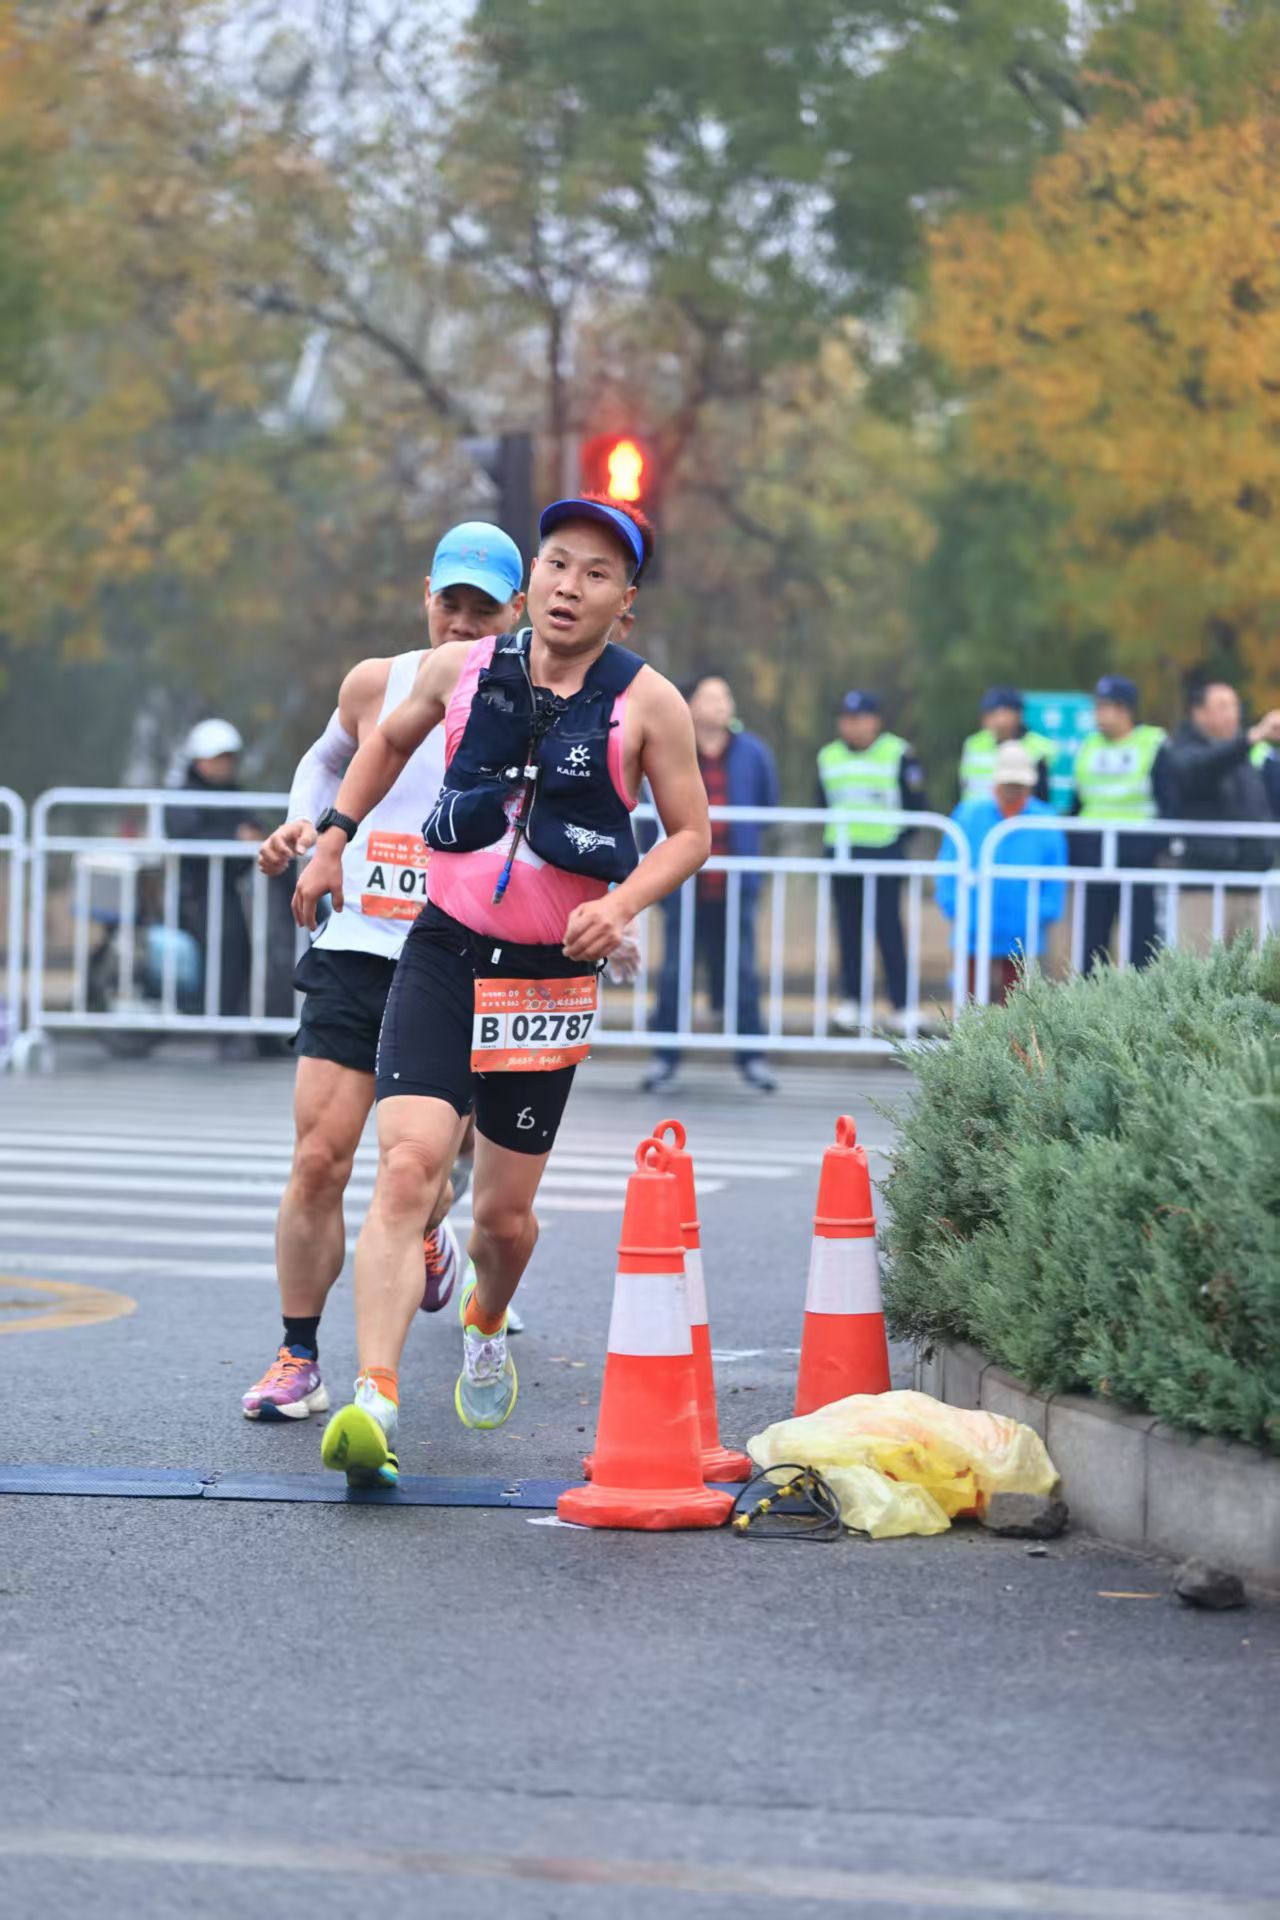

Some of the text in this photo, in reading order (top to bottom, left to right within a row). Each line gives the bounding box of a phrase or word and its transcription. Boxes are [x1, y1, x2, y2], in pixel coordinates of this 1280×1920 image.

[556, 765, 591, 777] KAILAS
[366, 865, 385, 889] A
[481, 1013, 594, 1043] B 02787
